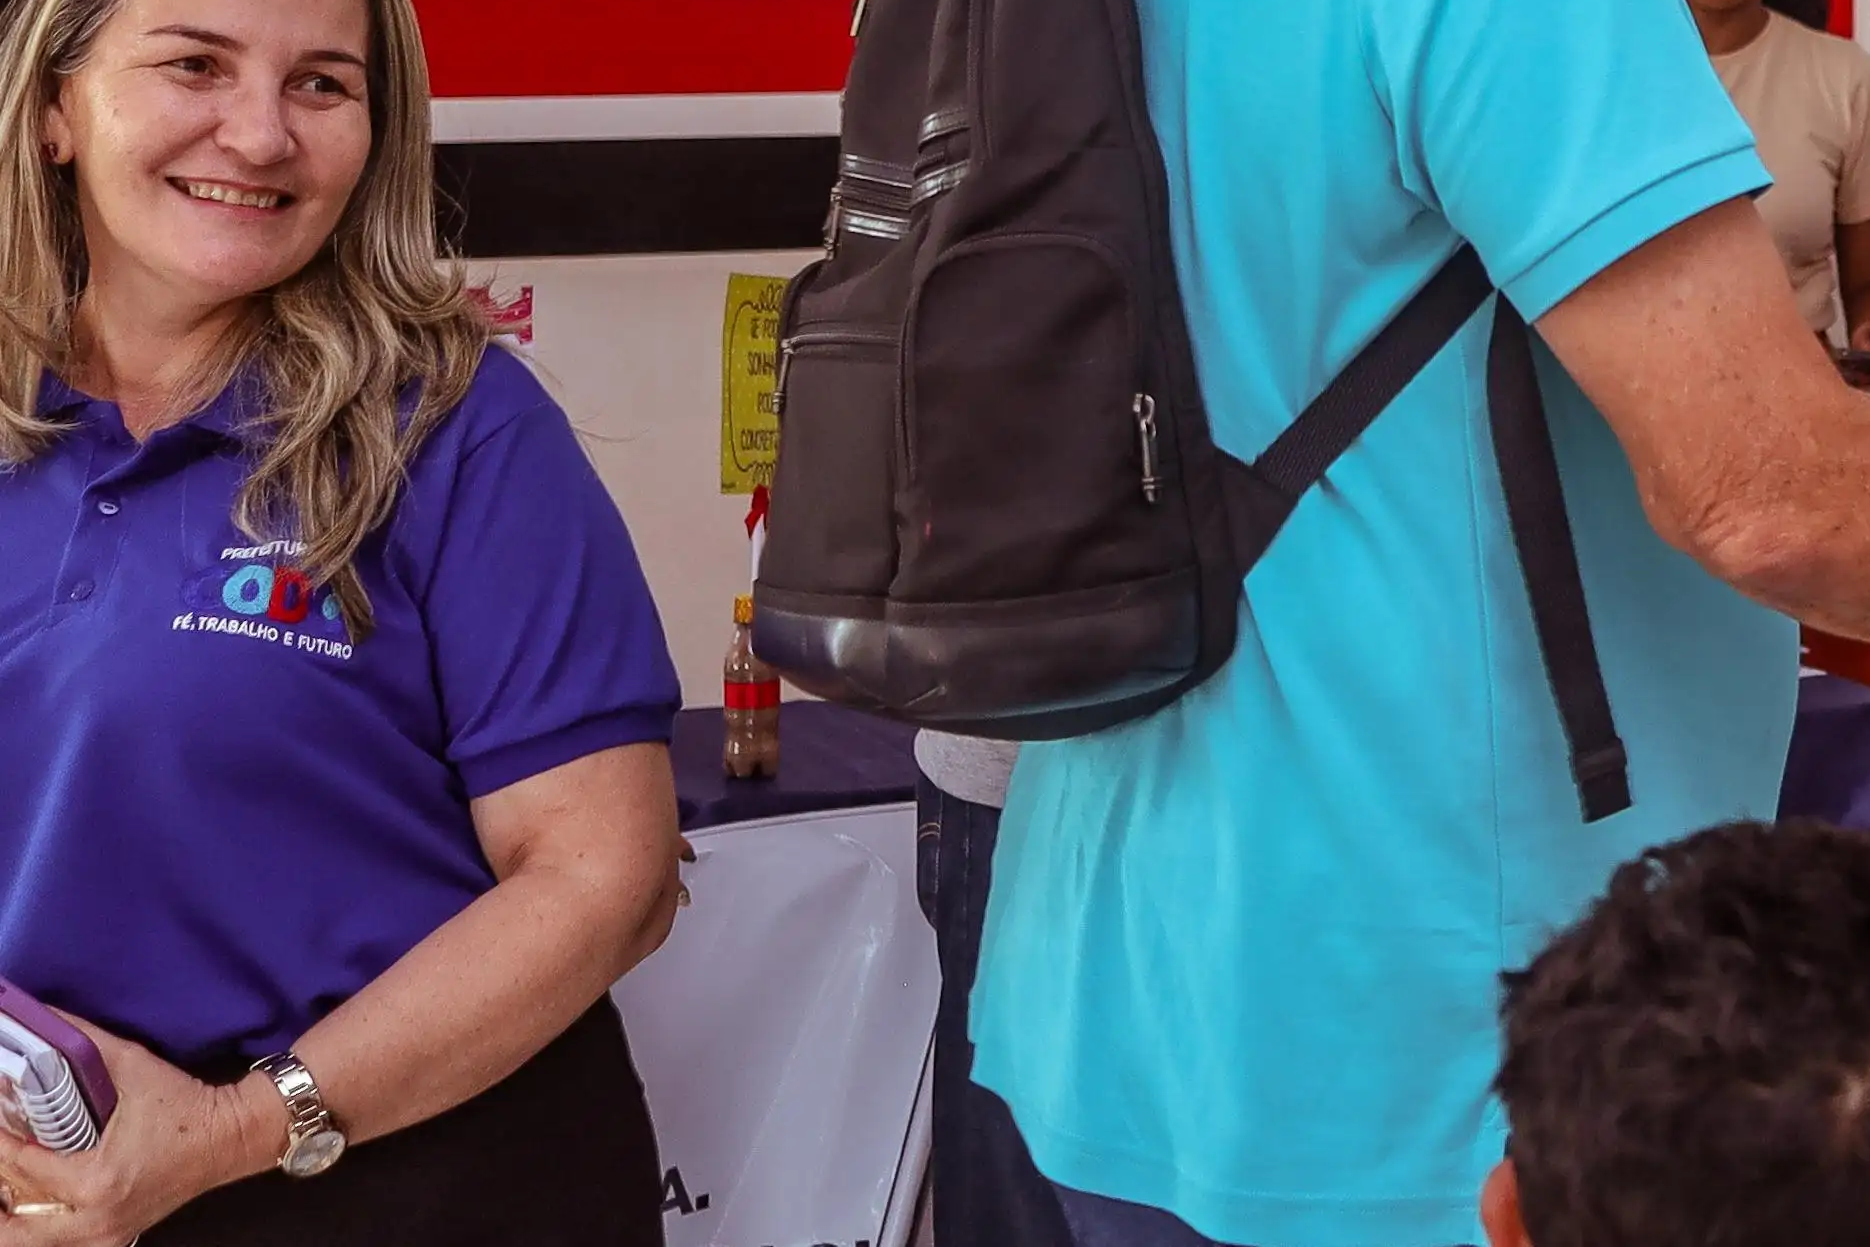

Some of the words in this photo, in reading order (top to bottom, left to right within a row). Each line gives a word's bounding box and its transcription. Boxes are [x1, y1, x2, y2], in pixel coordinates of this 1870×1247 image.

[198, 616, 279, 642] TRABALHO
[283, 631, 294, 646] E
[297, 634, 353, 660] FUTURO
